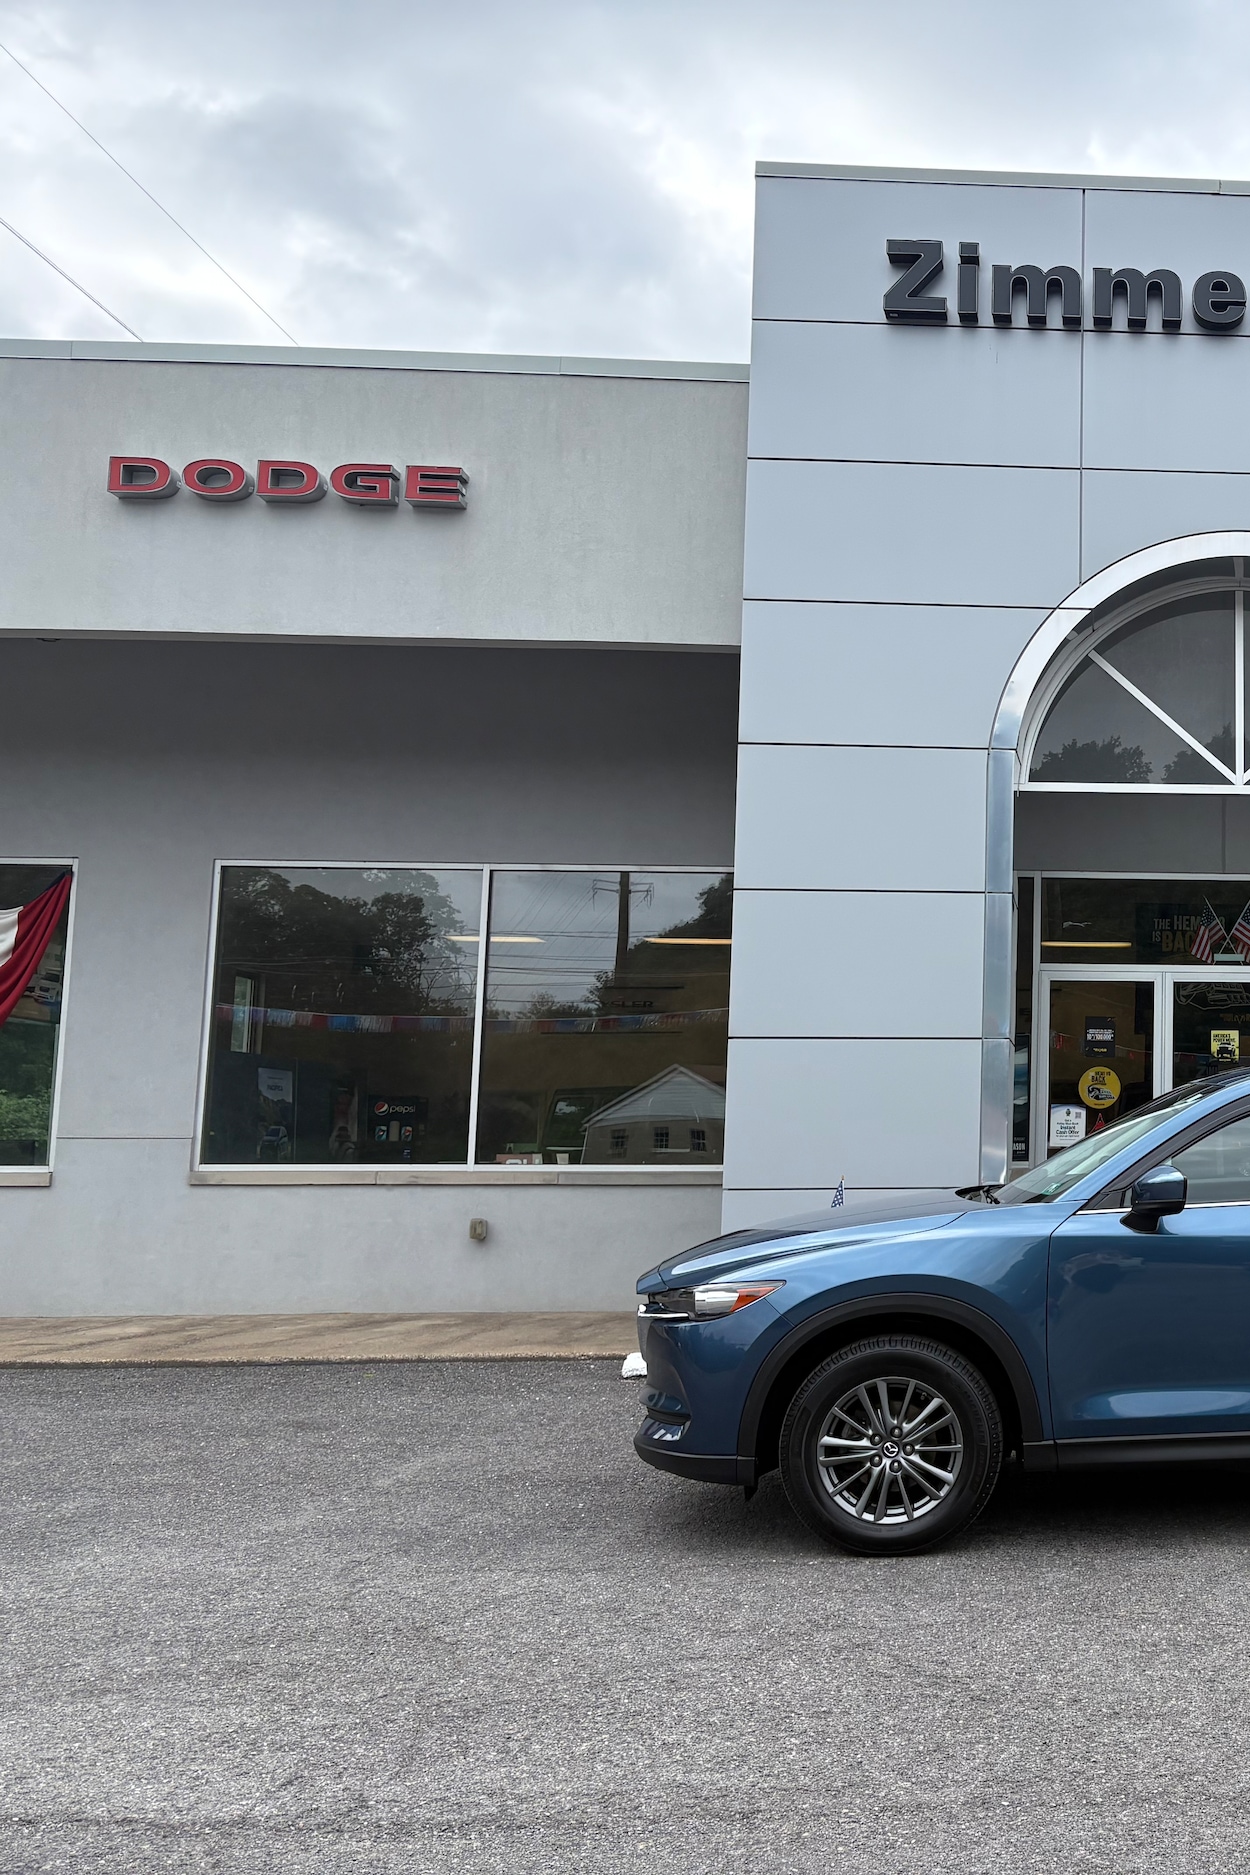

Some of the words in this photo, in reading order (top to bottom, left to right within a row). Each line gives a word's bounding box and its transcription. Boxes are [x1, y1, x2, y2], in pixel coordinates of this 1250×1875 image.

[107, 456, 470, 510] DODGE
[1153, 918, 1171, 930] THE
[1152, 931, 1161, 942] IS
[1162, 931, 1195, 953] BAC
[1091, 1075, 1106, 1083] BACK
[389, 1105, 416, 1114] pepsi
